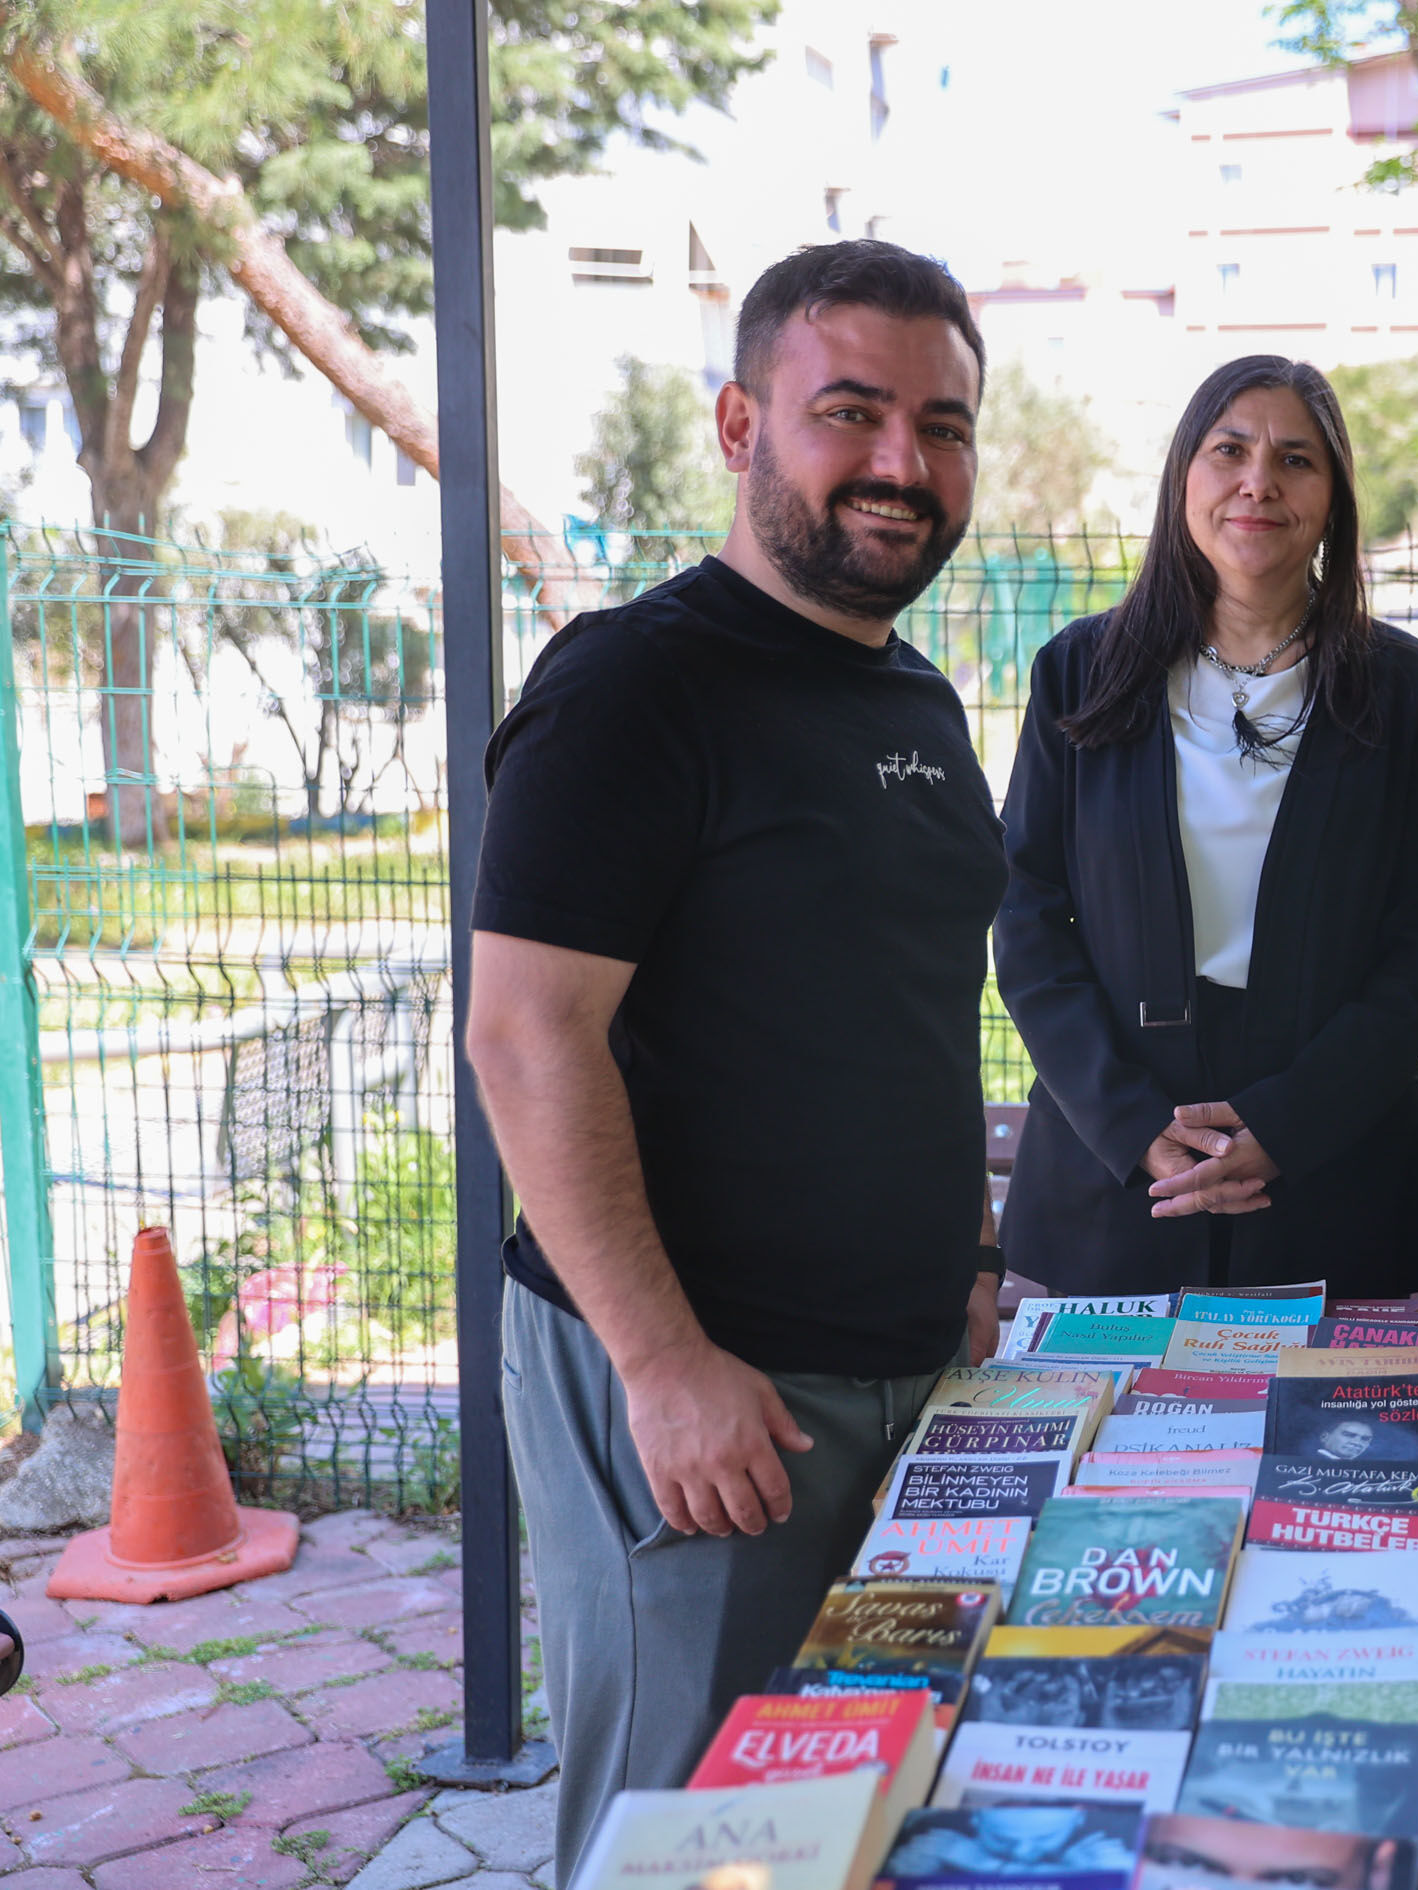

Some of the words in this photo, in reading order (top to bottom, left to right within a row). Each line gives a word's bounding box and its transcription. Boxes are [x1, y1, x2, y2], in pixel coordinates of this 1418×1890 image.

[1058, 1300, 1159, 1314] HALUK
[1217, 1328, 1280, 1341] Çocuk
[1184, 1338, 1224, 1350] Ruh
[944, 1368, 1011, 1383] AYŞE
[1174, 1373, 1213, 1382] Bircan
[1135, 1399, 1214, 1414] DOĞAN
[1321, 1399, 1368, 1410] insanlığa
[1370, 1399, 1386, 1410] yol
[931, 1421, 1009, 1435] HÜSEYİN
[1012, 1418, 1071, 1434] RAHMİ
[1167, 1424, 1207, 1435] freud
[924, 1432, 1068, 1449] GÜRPINAR
[913, 1465, 967, 1474] STEFAN
[970, 1465, 1014, 1473] ZWEIG
[1108, 1468, 1135, 1476] Koza
[1193, 1466, 1232, 1475] Bilmez
[1275, 1464, 1312, 1476] GAZİ
[1316, 1468, 1387, 1480] MUSTAFA
[908, 1472, 1028, 1486] BİLİNMEYEN
[905, 1485, 940, 1497] BİR
[945, 1487, 1028, 1497] KADININ
[901, 1498, 999, 1510] MEKTUBU
[880, 1518, 1022, 1537] AHMET
[917, 1534, 1018, 1555] ÜMİT
[973, 1555, 1012, 1566] Kar
[1081, 1547, 1178, 1567] DAN
[1030, 1567, 1215, 1596] BROWN
[1243, 1647, 1330, 1662] STEFAN
[1337, 1645, 1415, 1660] ZWEIG
[827, 1670, 930, 1688] Trevanian
[1277, 1667, 1376, 1680] HAYATIN
[755, 1702, 836, 1719] AHMET
[842, 1699, 902, 1718] ÜMİT
[1014, 1735, 1131, 1753] TOLSTOY
[1267, 1729, 1306, 1745] BU
[730, 1728, 880, 1769] ELVEDA
[1217, 1743, 1259, 1759] BİR
[1271, 1745, 1412, 1764] YALNIZLIK
[971, 1756, 1026, 1784] İNSAN
[1030, 1764, 1056, 1785] NE
[1061, 1760, 1086, 1787] İLE
[1093, 1769, 1151, 1791] YAŞAR
[675, 1816, 777, 1852] ANA
